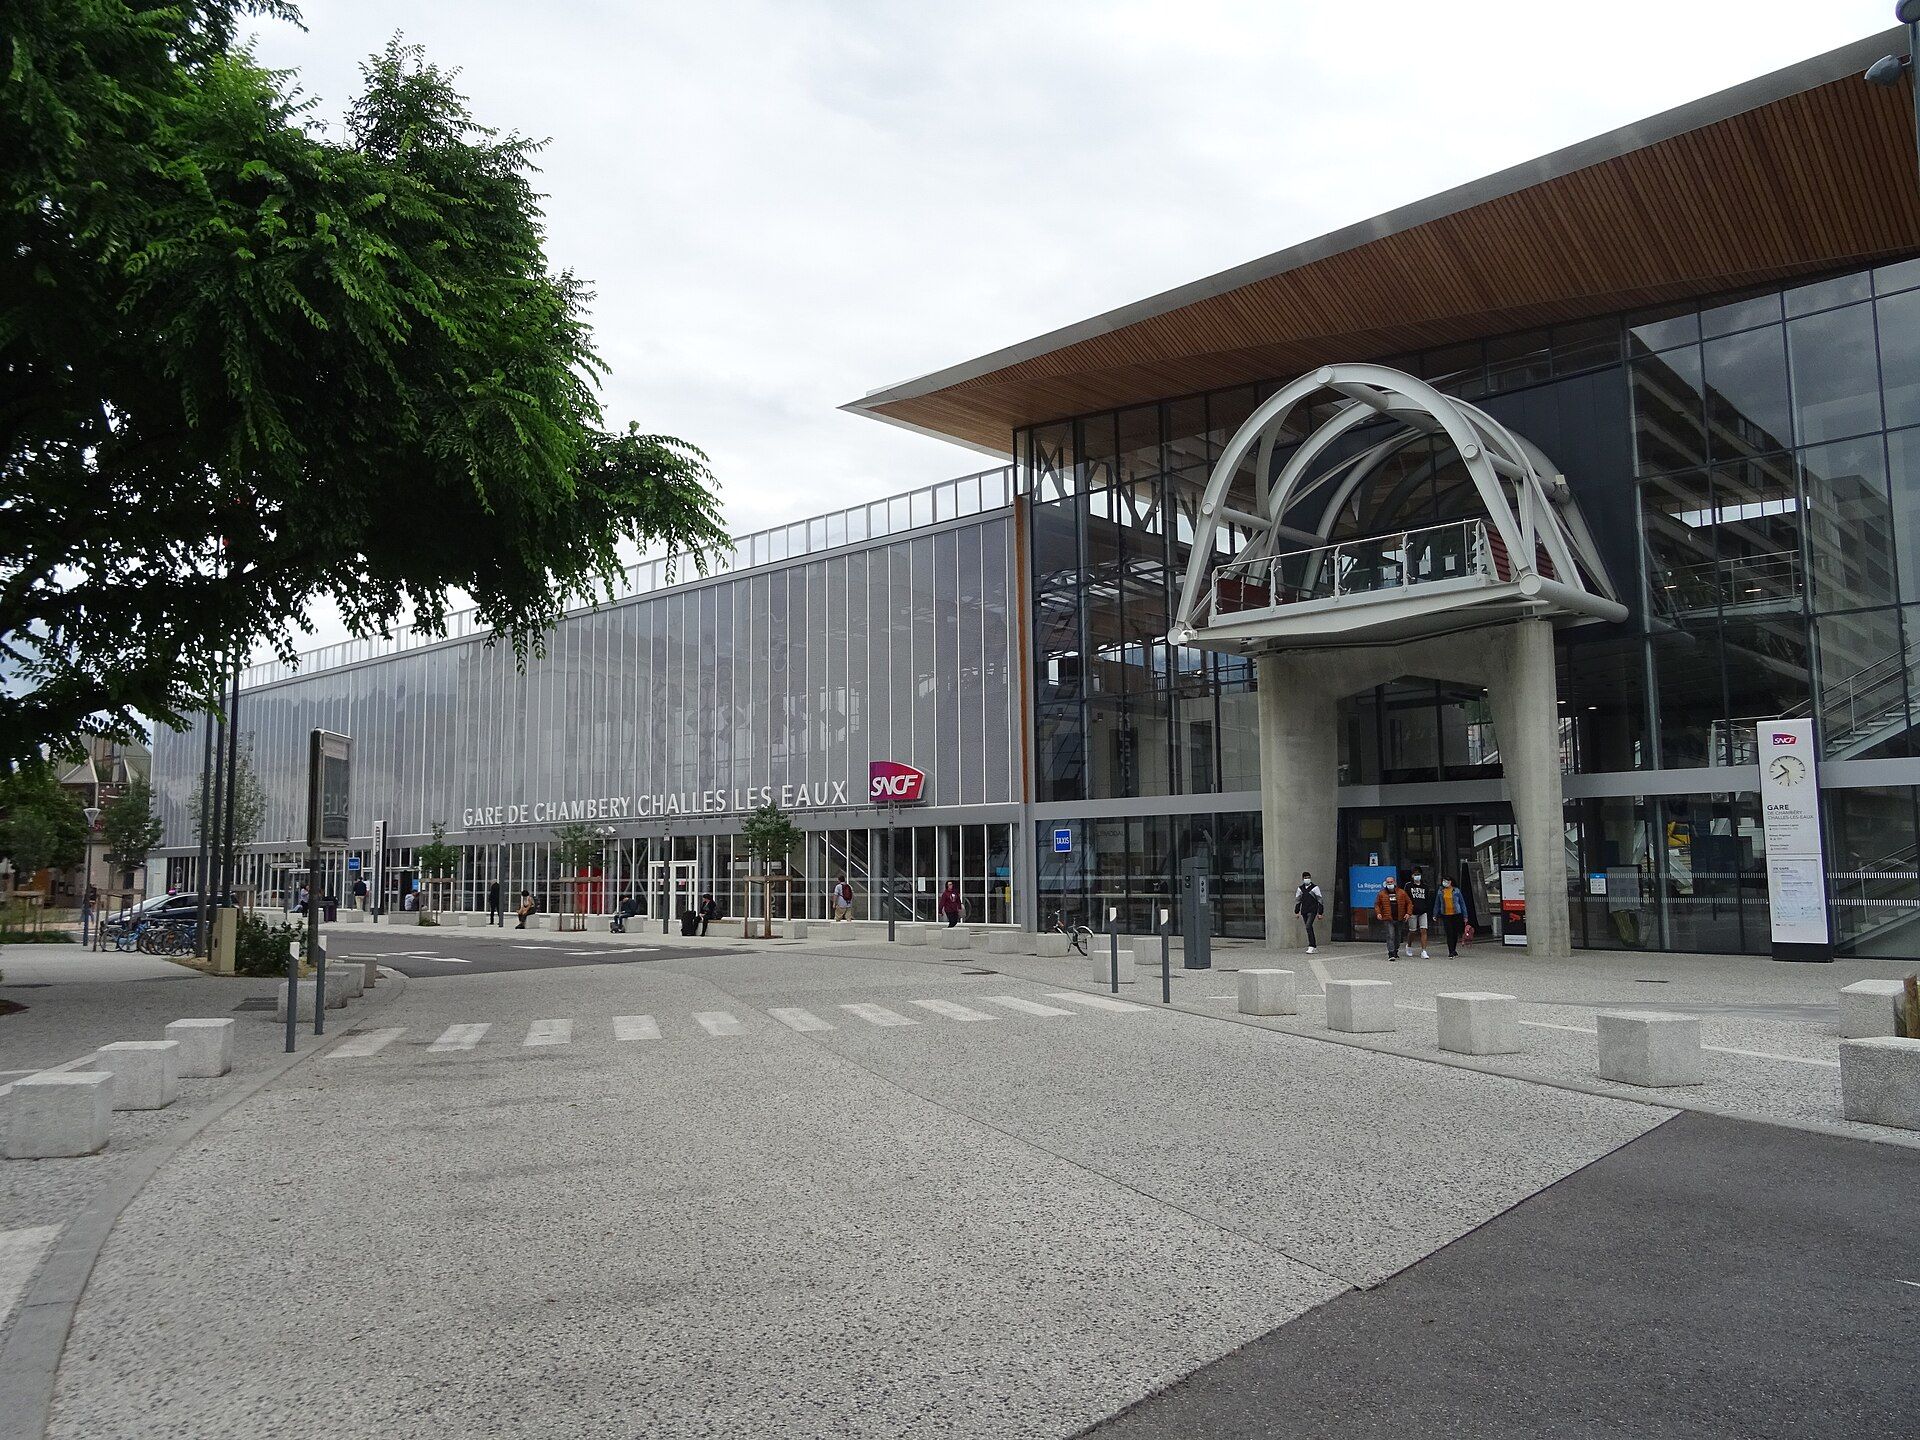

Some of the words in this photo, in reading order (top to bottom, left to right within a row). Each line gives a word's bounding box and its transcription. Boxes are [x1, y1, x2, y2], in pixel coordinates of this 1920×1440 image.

[1774, 736, 1796, 745] SNCF
[870, 774, 919, 797] SNCF
[462, 806, 503, 827] GARE
[508, 804, 529, 824] DE
[534, 797, 631, 822] CHAMBERY
[637, 789, 726, 816] CHALLES
[735, 786, 772, 811] LES
[781, 780, 847, 808] EAUX
[1056, 837, 1069, 845] TAXIS
